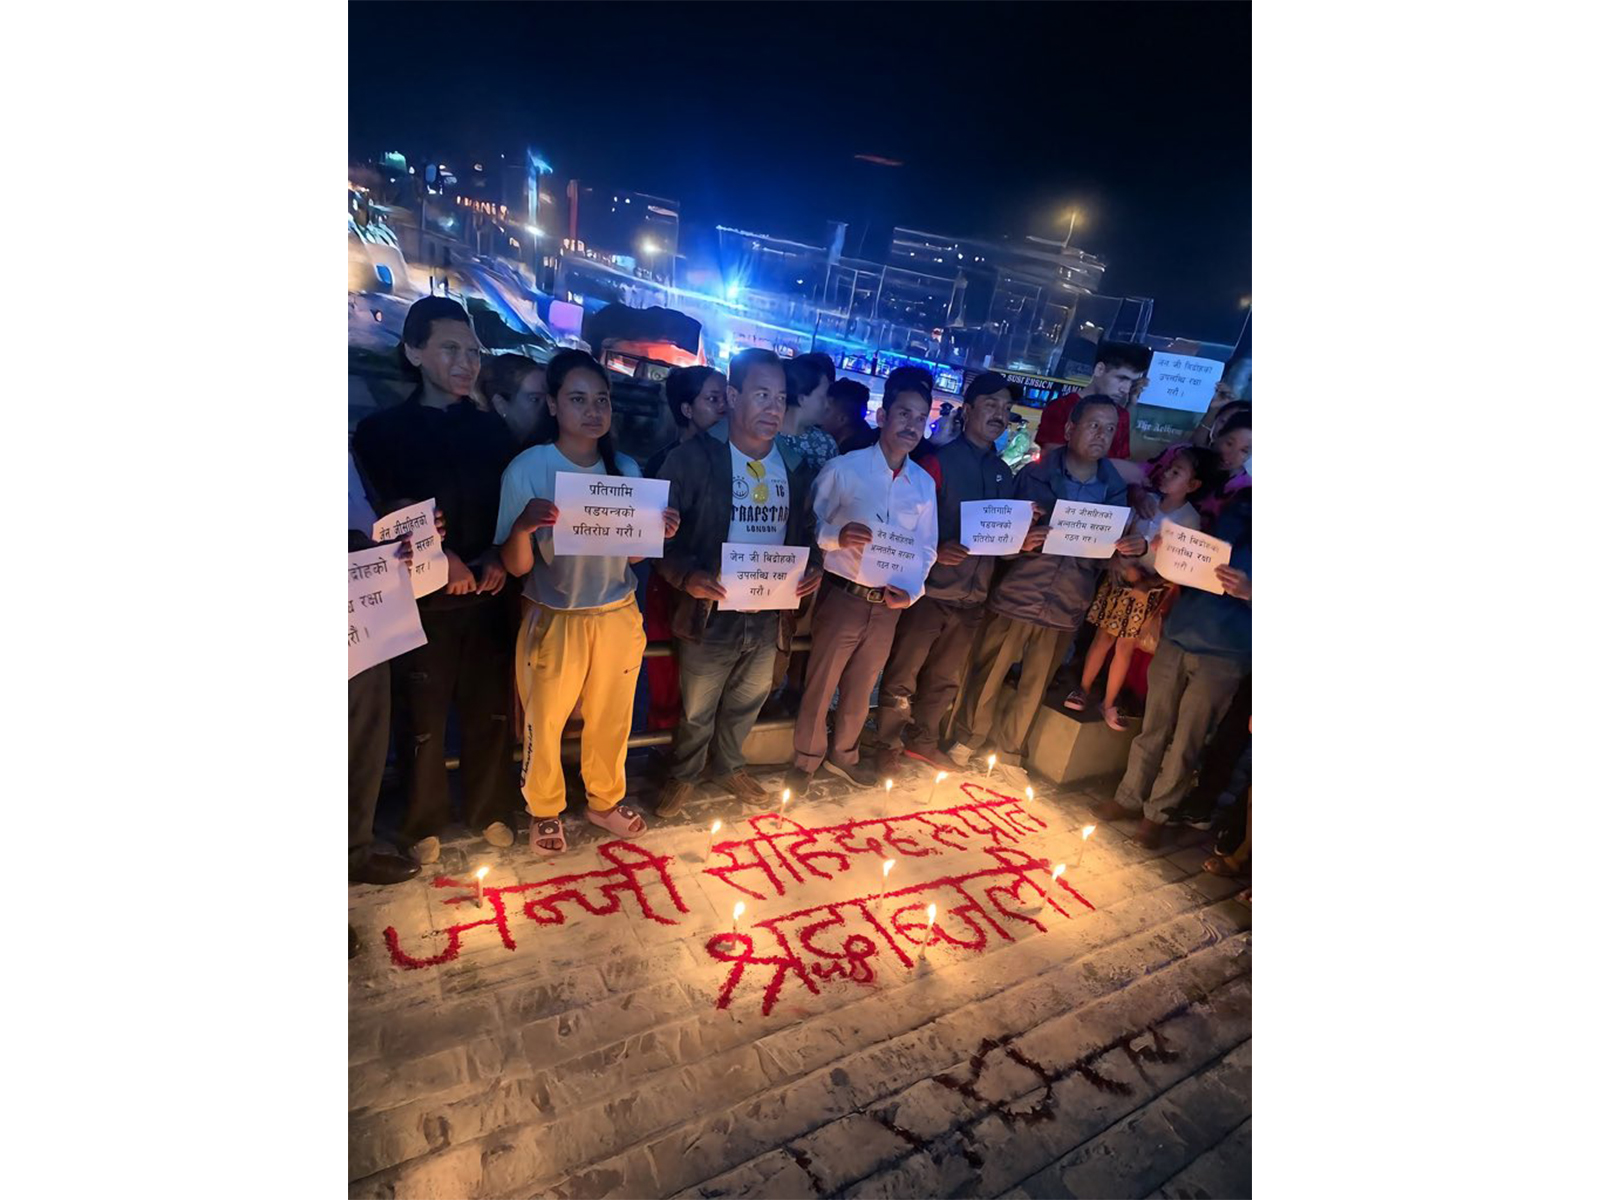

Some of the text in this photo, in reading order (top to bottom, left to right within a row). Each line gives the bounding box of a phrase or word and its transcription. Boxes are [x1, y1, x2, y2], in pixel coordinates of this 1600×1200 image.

[589, 481, 634, 497] प्रतिगामि
[573, 522, 611, 536] प्रतिरोध
[746, 525, 777, 533] LONDON
[729, 550, 745, 562] जेन
[749, 550, 759, 563] जी
[772, 572, 787, 580] रक्षा
[359, 590, 383, 608] रक्षा
